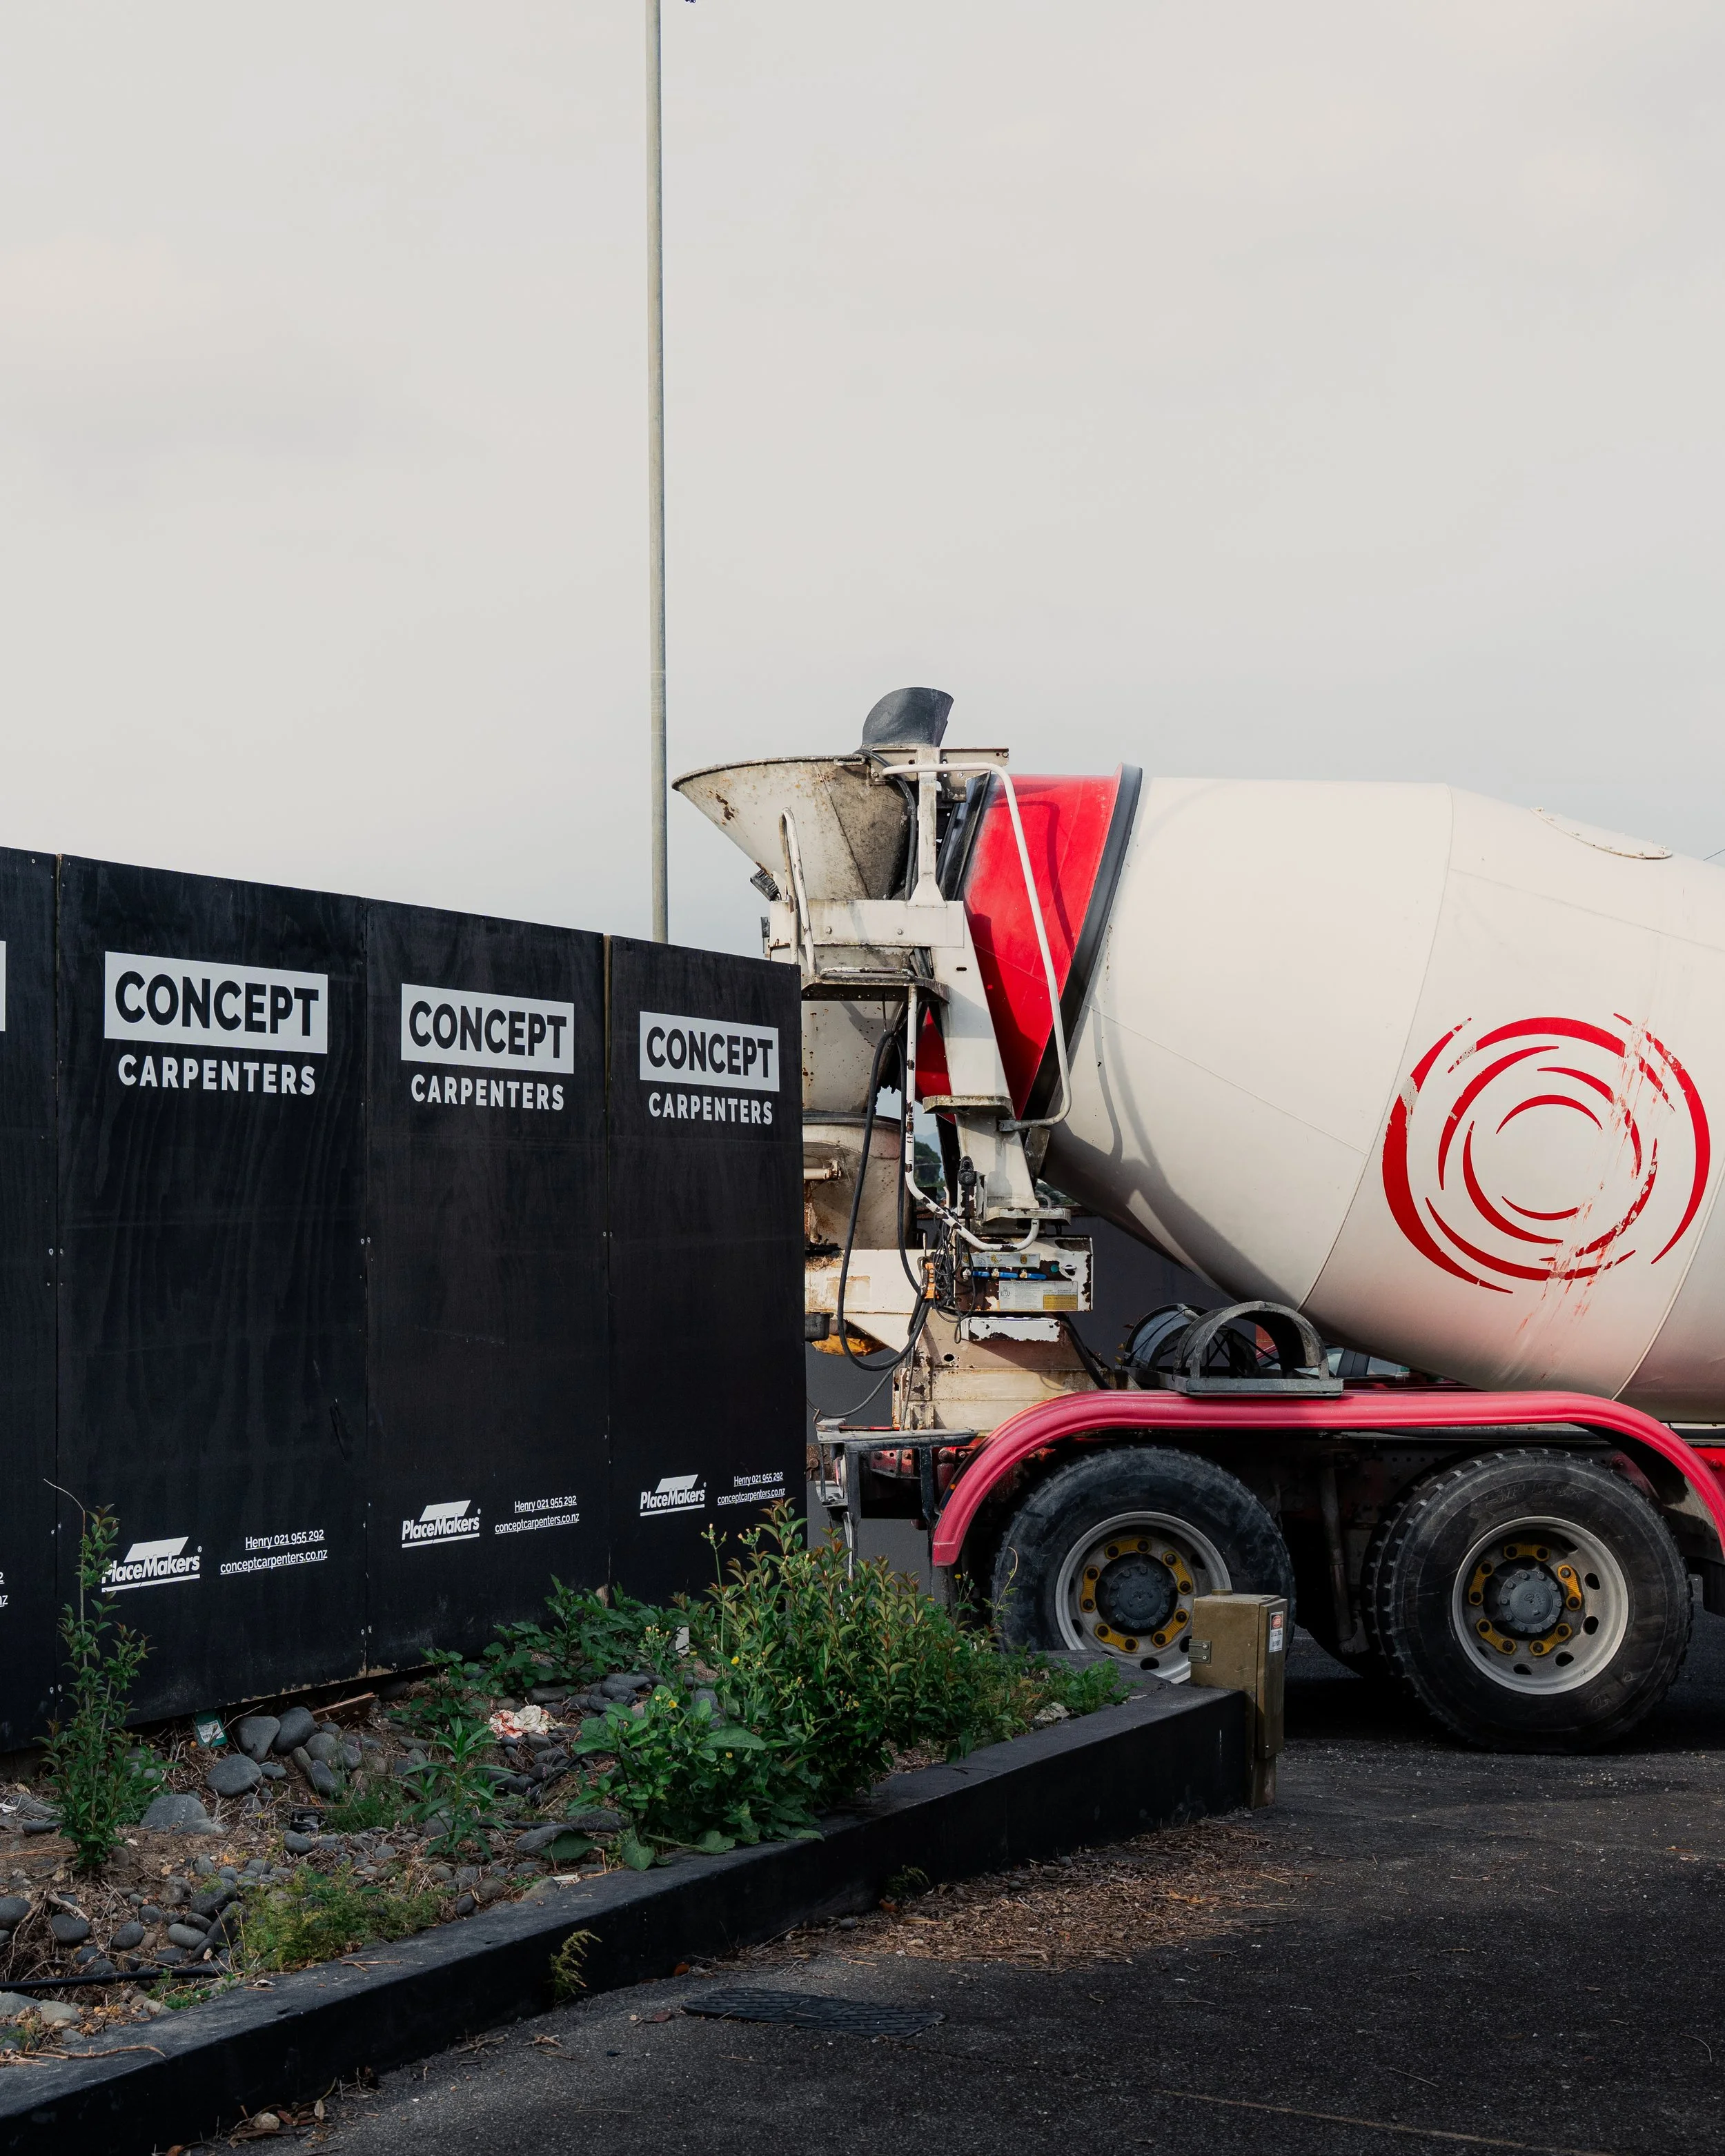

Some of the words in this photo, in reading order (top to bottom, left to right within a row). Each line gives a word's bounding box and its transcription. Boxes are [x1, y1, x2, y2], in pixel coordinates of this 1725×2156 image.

[115, 970, 319, 1037] CONCEPT
[408, 1000, 567, 1059] CONCEPT
[646, 1026, 773, 1078] CONCEPT
[118, 1054, 316, 1096] CARPENTERS
[411, 1074, 564, 1111] CARPENTERS
[649, 1091, 773, 1125] CARPENTERS
[733, 1475, 751, 1487] Henry
[751, 1474, 762, 1483] 021
[762, 1473, 773, 1484] 955
[773, 1472, 783, 1482] 292
[514, 1501, 535, 1512] Henry
[536, 1499, 549, 1509] 021
[550, 1497, 563, 1509] 955
[564, 1495, 577, 1506] 292
[640, 1485, 705, 1510] PlaceMakers
[717, 1487, 785, 1505] conceptcarpenters.co.nz
[402, 1512, 480, 1541] PlaceMakers
[495, 1513, 580, 1533] conceptcarpenters.co.nz
[245, 1536, 273, 1550] Henry
[274, 1534, 290, 1545] 021
[291, 1531, 306, 1545] 955
[308, 1529, 324, 1542] 292
[219, 1550, 328, 1573] conceptcarpenters.co.nz
